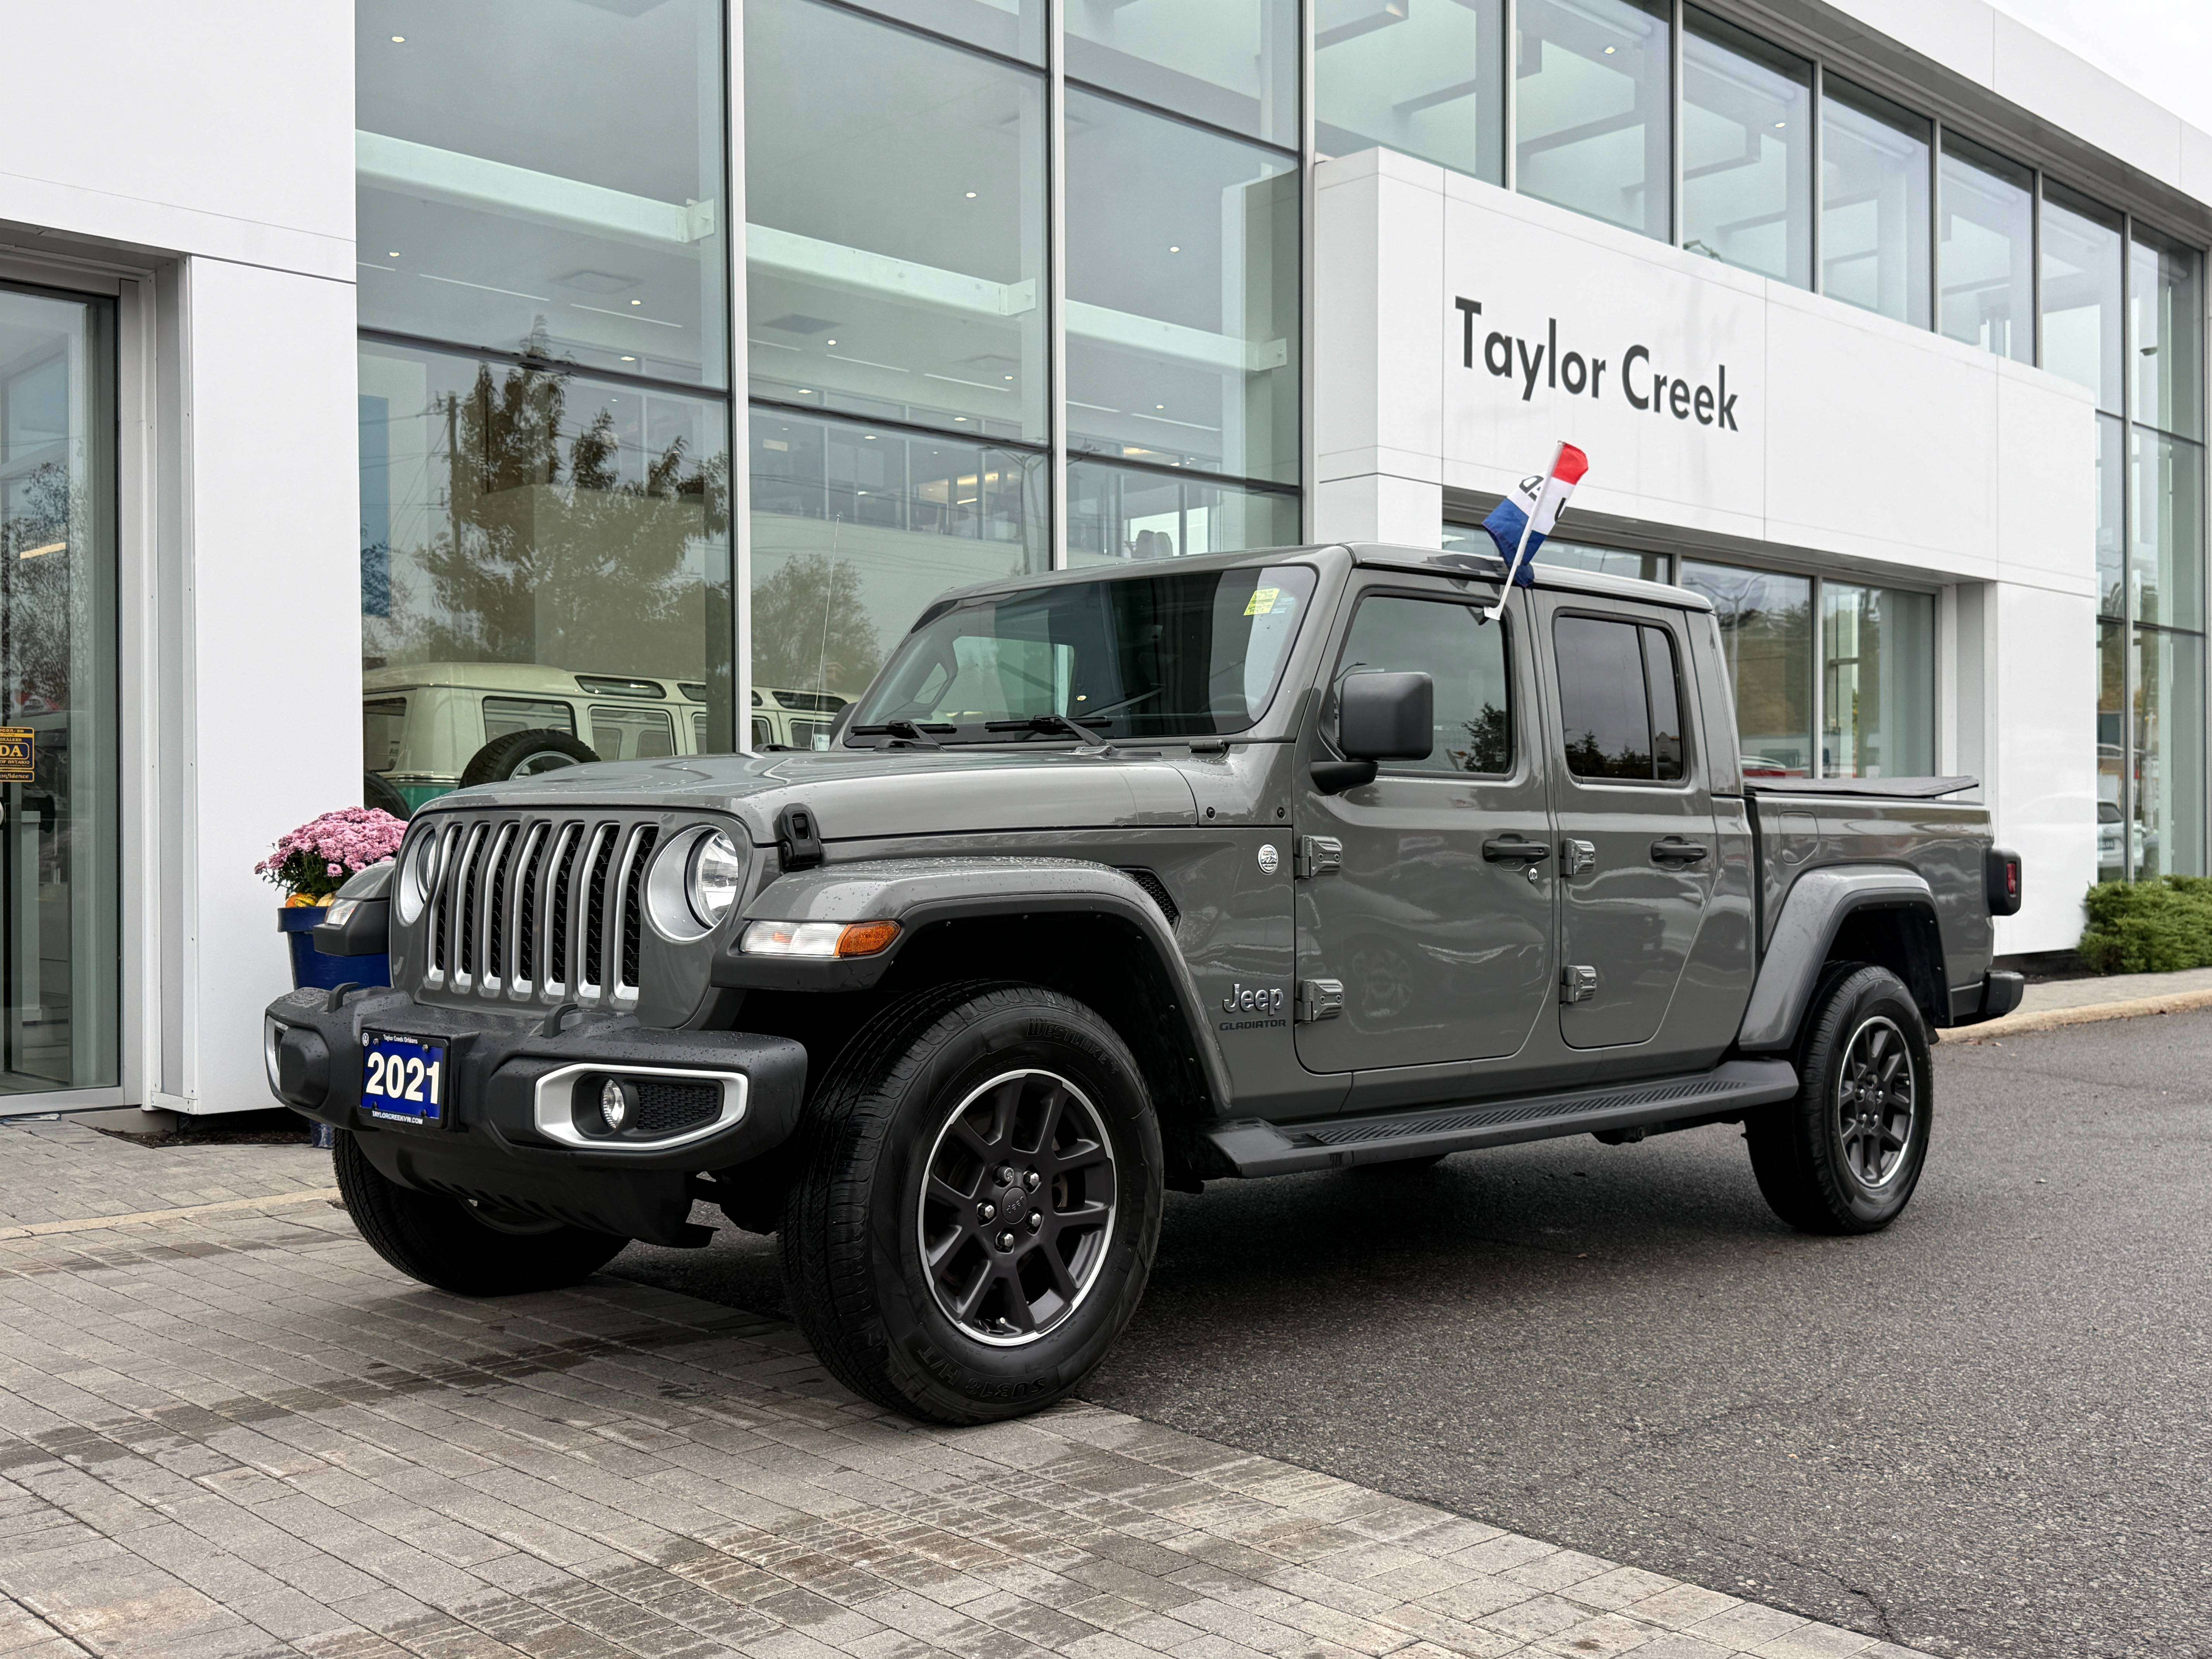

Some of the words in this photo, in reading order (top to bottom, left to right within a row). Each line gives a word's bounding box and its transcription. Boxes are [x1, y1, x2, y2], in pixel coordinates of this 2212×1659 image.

[1455, 295, 1606, 401] Taylor
[1621, 344, 1738, 432] Creek
[1223, 984, 1284, 1016] Jeep
[1219, 1019, 1286, 1031] GLADIATOR
[1026, 1021, 1110, 1065] WESTLAKE
[366, 1052, 440, 1104] 2021
[372, 1111, 423, 1125] TAYLORCREEKVW.COM
[965, 1376, 1046, 1399] SU318
